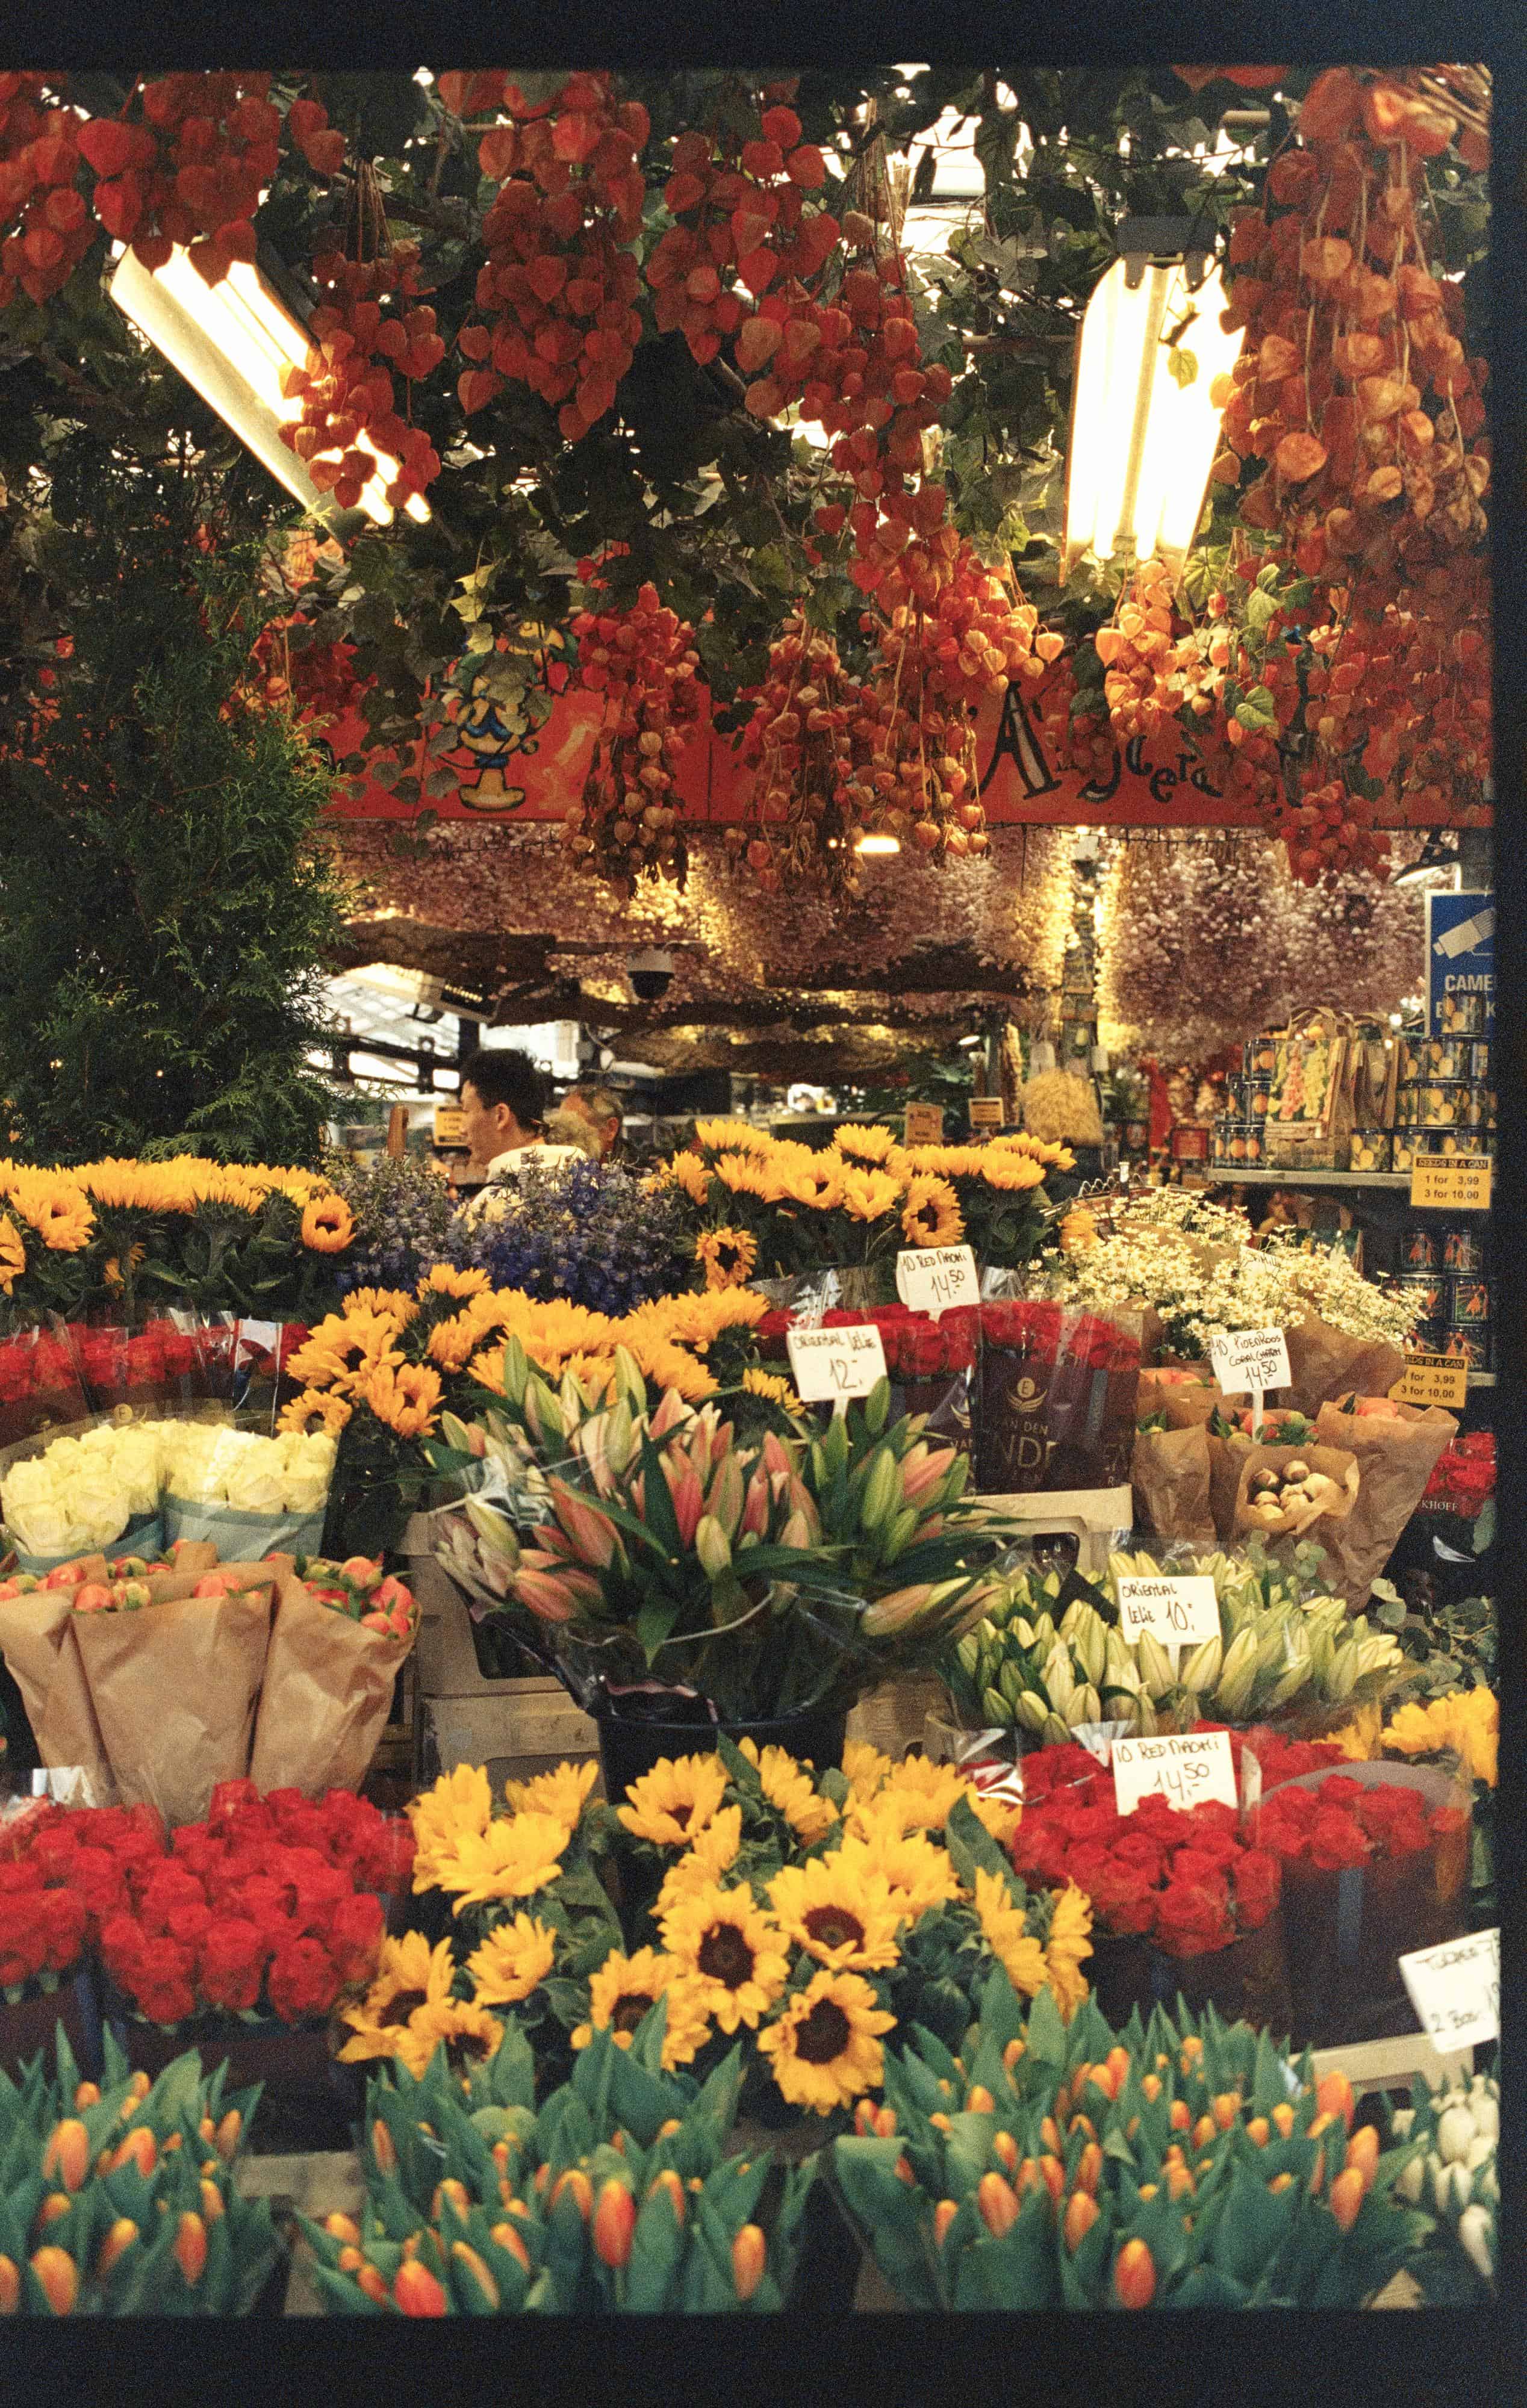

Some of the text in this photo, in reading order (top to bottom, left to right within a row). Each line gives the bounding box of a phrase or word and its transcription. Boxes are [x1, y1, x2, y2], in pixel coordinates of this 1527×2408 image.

[1468, 1160, 1488, 1169] CAN
[1425, 1175, 1431, 1184] 1
[1434, 1175, 1448, 1184] for
[1425, 1189, 1431, 1198] 3
[1434, 1189, 1448, 1199] for
[901, 1255, 916, 1272] 10
[916, 1255, 936, 1268] RED
[1213, 1338, 1228, 1358] 10
[1228, 1352, 1257, 1367] CORAL
[1425, 1356, 1434, 1366] IN
[1435, 1358, 1443, 1367] A
[1445, 1358, 1464, 1370] CAN
[1410, 1371, 1426, 1382] for
[1401, 1385, 1407, 1394] 3
[1410, 1386, 1426, 1396] for
[1115, 1743, 1133, 1763] 10
[1137, 1740, 1167, 1760] RED
